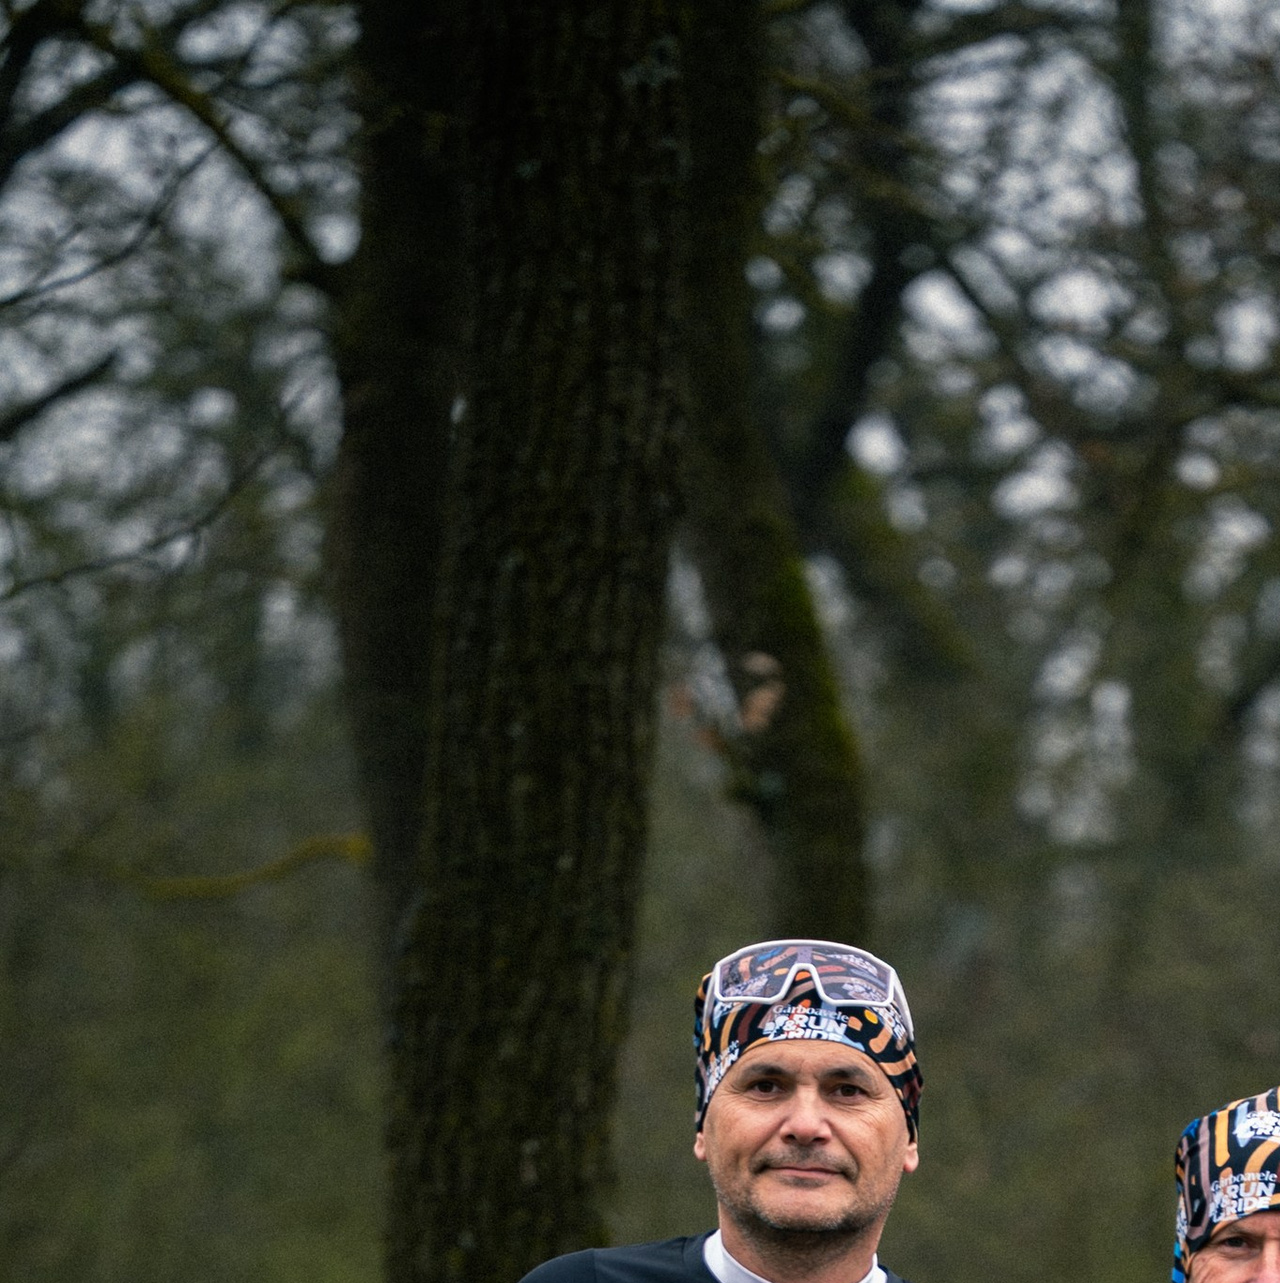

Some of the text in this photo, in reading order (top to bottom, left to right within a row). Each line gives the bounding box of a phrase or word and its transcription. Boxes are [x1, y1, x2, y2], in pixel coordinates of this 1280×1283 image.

[793, 1014, 847, 1034] RUN
[1226, 1181, 1276, 1199] RUN
[1226, 1196, 1271, 1214] RIDE
